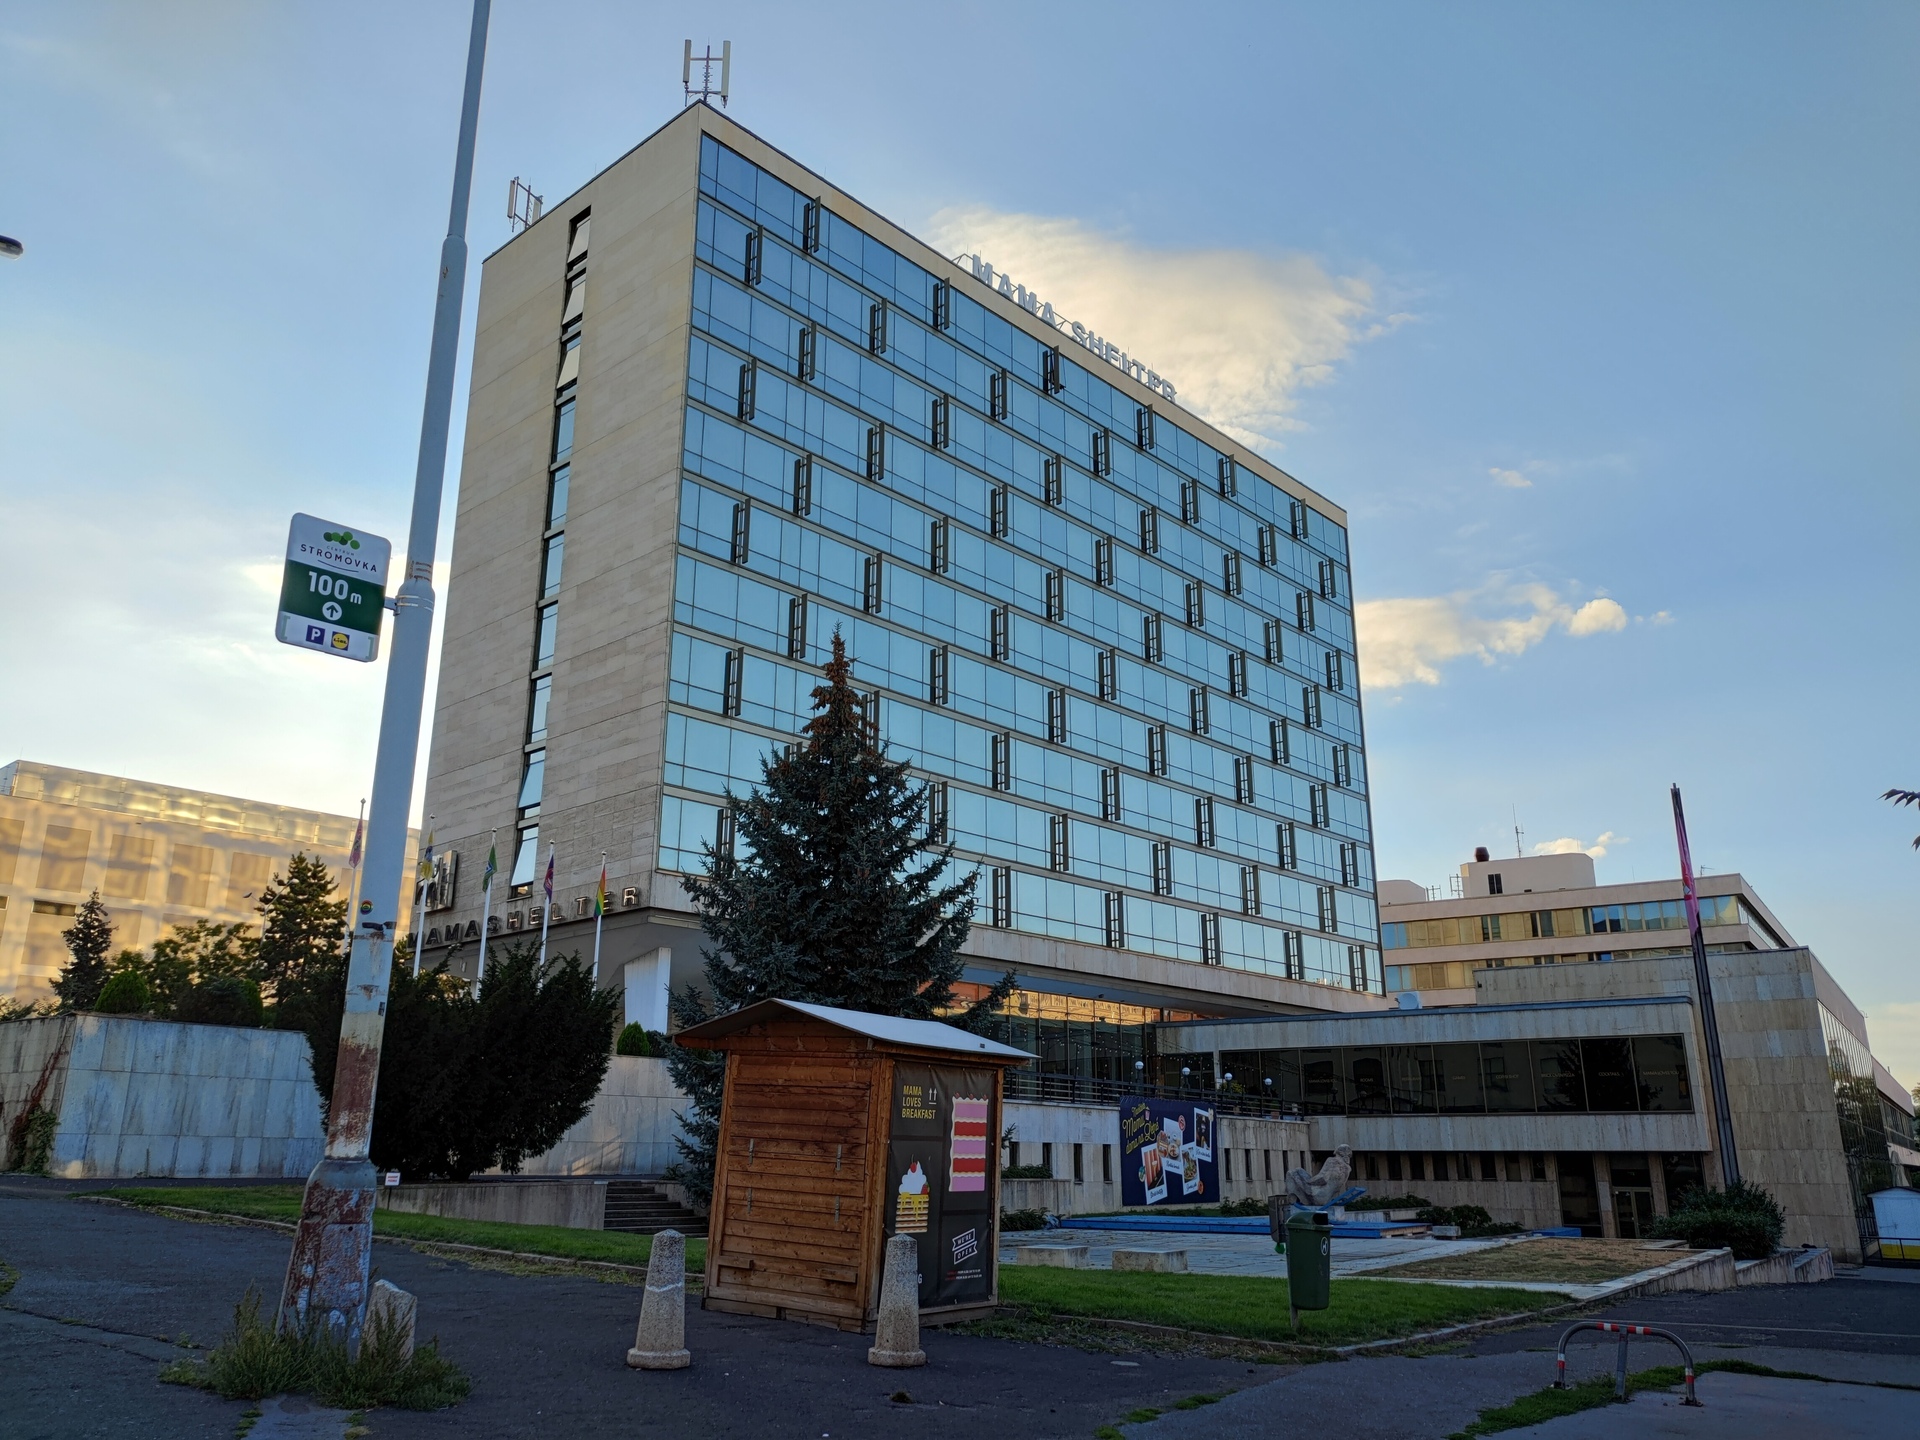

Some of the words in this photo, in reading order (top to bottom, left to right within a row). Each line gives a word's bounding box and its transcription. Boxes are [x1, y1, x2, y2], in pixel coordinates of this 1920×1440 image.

[972, 253, 1057, 328] MAMA
[1071, 321, 1176, 403] SHELTER
[326, 545, 354, 556] CENTRUM
[300, 543, 377, 573] STROMOVKA
[311, 628, 321, 642] P
[487, 887, 639, 935] SHELTER
[903, 1085, 922, 1097] MAMA
[902, 1097, 922, 1108] LOVES
[901, 1107, 936, 1120] BREAKFAST
[957, 1233, 972, 1245] WE'RE
[957, 1246, 973, 1259] OPEN
